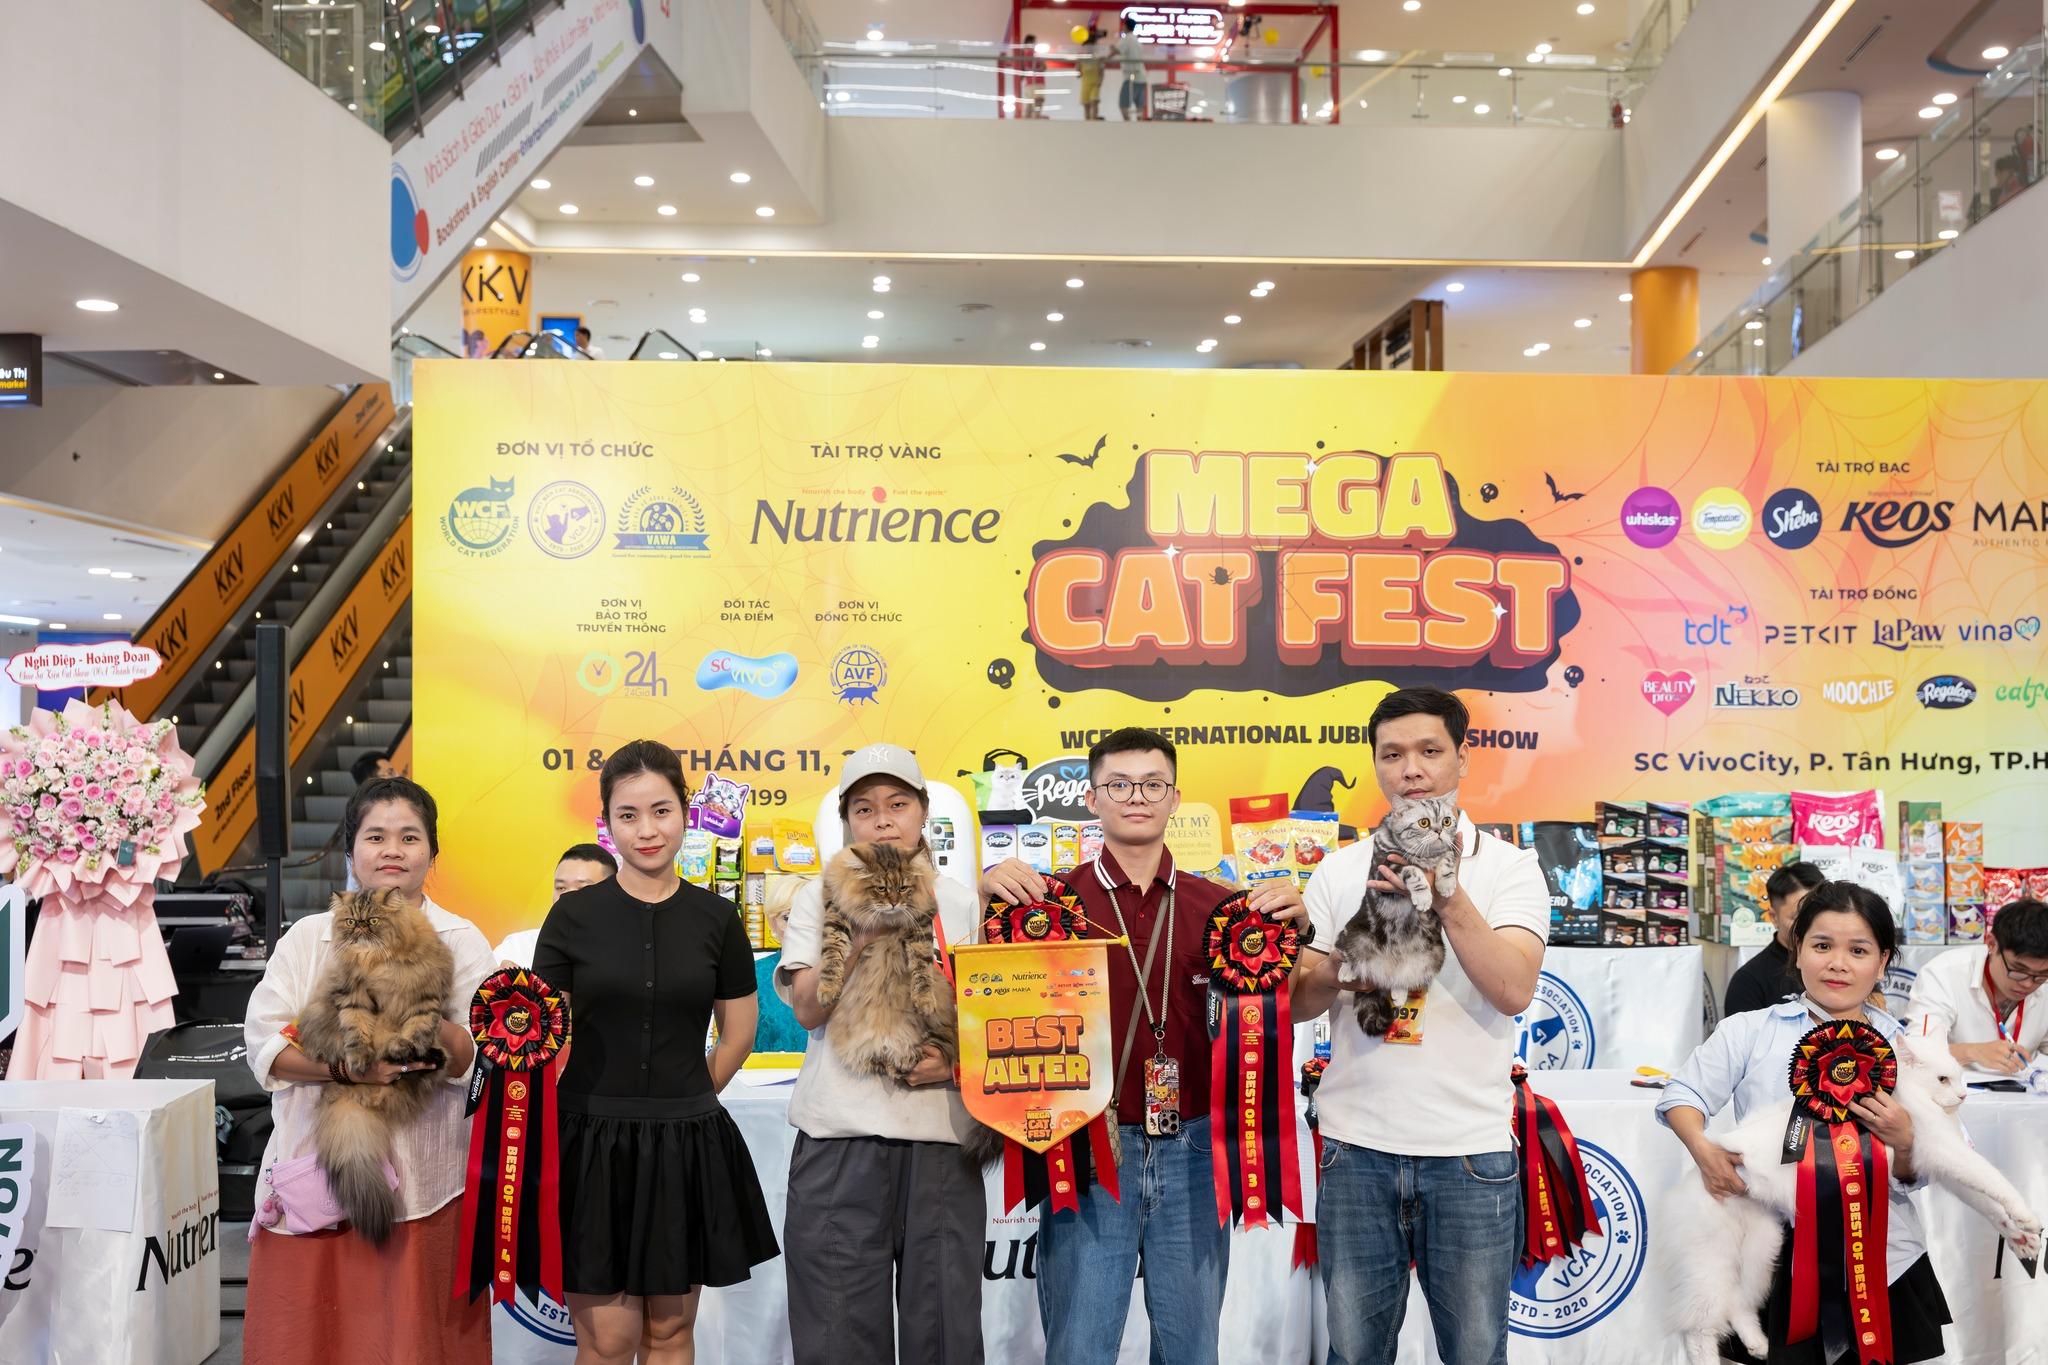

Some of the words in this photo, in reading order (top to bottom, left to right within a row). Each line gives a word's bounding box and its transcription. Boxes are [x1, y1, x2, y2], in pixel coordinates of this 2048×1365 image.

[496, 440, 540, 456] ĐƠN
[545, 443, 564, 459] VỊ
[569, 438, 595, 456] TỔ
[600, 440, 654, 458] CHỨC
[810, 441, 840, 458] TÀI
[846, 443, 884, 462] TRỢ
[889, 441, 941, 460] VÀNG
[1816, 461, 1839, 473] TÀI
[1844, 461, 1875, 474] TRỢ
[1880, 462, 1911, 477] BẠC
[452, 500, 506, 519] WCF
[1146, 450, 1457, 546] MEGA
[750, 499, 1000, 545] Nutrience
[1626, 512, 1677, 526] whiskas
[1768, 503, 1819, 538] Sheba
[440, 515, 457, 548] WORLD
[457, 545, 475, 559] CAT
[479, 515, 520, 559] FEDERATION
[646, 535, 677, 546] VAWA
[600, 598, 627, 611] ĐƠN
[631, 599, 642, 613] VỊ
[748, 599, 770, 610] TÁC
[838, 600, 865, 610] ĐƠN
[868, 601, 879, 613] VỊ
[1030, 547, 1260, 662] CAT
[1276, 548, 1571, 664] FEST
[1809, 587, 1833, 600] TÀI
[1838, 588, 1868, 602] TRỢ
[624, 610, 648, 624] TRỢ
[720, 612, 741, 623] ĐỊA
[871, 612, 903, 622] CHỨC
[1684, 613, 1732, 645] tdt
[1765, 625, 1857, 644] PETKIT
[1872, 618, 1946, 651] LaPaw
[710, 657, 732, 673] SC
[843, 667, 875, 680] AVF
[1643, 680, 1694, 694] BEAUTY
[1822, 679, 1895, 706] MOOCHIE
[1923, 680, 1972, 706] Regalos
[1155, 725, 1312, 746] ERNATIONAL
[1318, 725, 1369, 744] JUBI
[1465, 728, 1539, 750] SHOW
[542, 748, 574, 771] 01
[796, 749, 831, 777] 11,
[1634, 752, 1668, 771] SC
[1678, 750, 1799, 777] VivoCity,
[1810, 753, 1834, 771] P.
[1842, 750, 1890, 771] Tân
[1901, 751, 1981, 776] Hưng,
[1035, 774, 1091, 812] Rega
[1012, 970, 1047, 981] Nutrience
[1209, 991, 1217, 1026] Nutrience
[1534, 984, 1580, 1034] SSOCIATION
[986, 1015, 1084, 1056] BEST
[470, 1067, 484, 1102] Nutrience
[983, 1053, 1092, 1094] ALTER
[1244, 1070, 1257, 1107] BEST
[1027, 1119, 1051, 1130] CAT
[1244, 1108, 1256, 1128] OF
[1026, 1129, 1052, 1140] FEST
[1789, 1115, 1803, 1151] Nutrience
[1244, 1130, 1257, 1166] BEST
[504, 1146, 519, 1185] BEST
[1247, 1173, 1258, 1188] 3
[1582, 1160, 1629, 1222] OCIATION
[502, 1185, 515, 1205] OF
[1539, 1190, 1551, 1217] BEST
[500, 1205, 514, 1242] BEST
[992, 1216, 1027, 1225] Nourish
[1544, 1220, 1554, 1233] 2
[1849, 1202, 1862, 1239] BEST
[1852, 1241, 1864, 1262] OF
[1552, 1247, 1597, 1289] VCA
[1854, 1263, 1869, 1300] BEST
[1509, 1297, 1538, 1318] STD
[1554, 1296, 1589, 1320] 2020
[1859, 1308, 1872, 1324] 2
